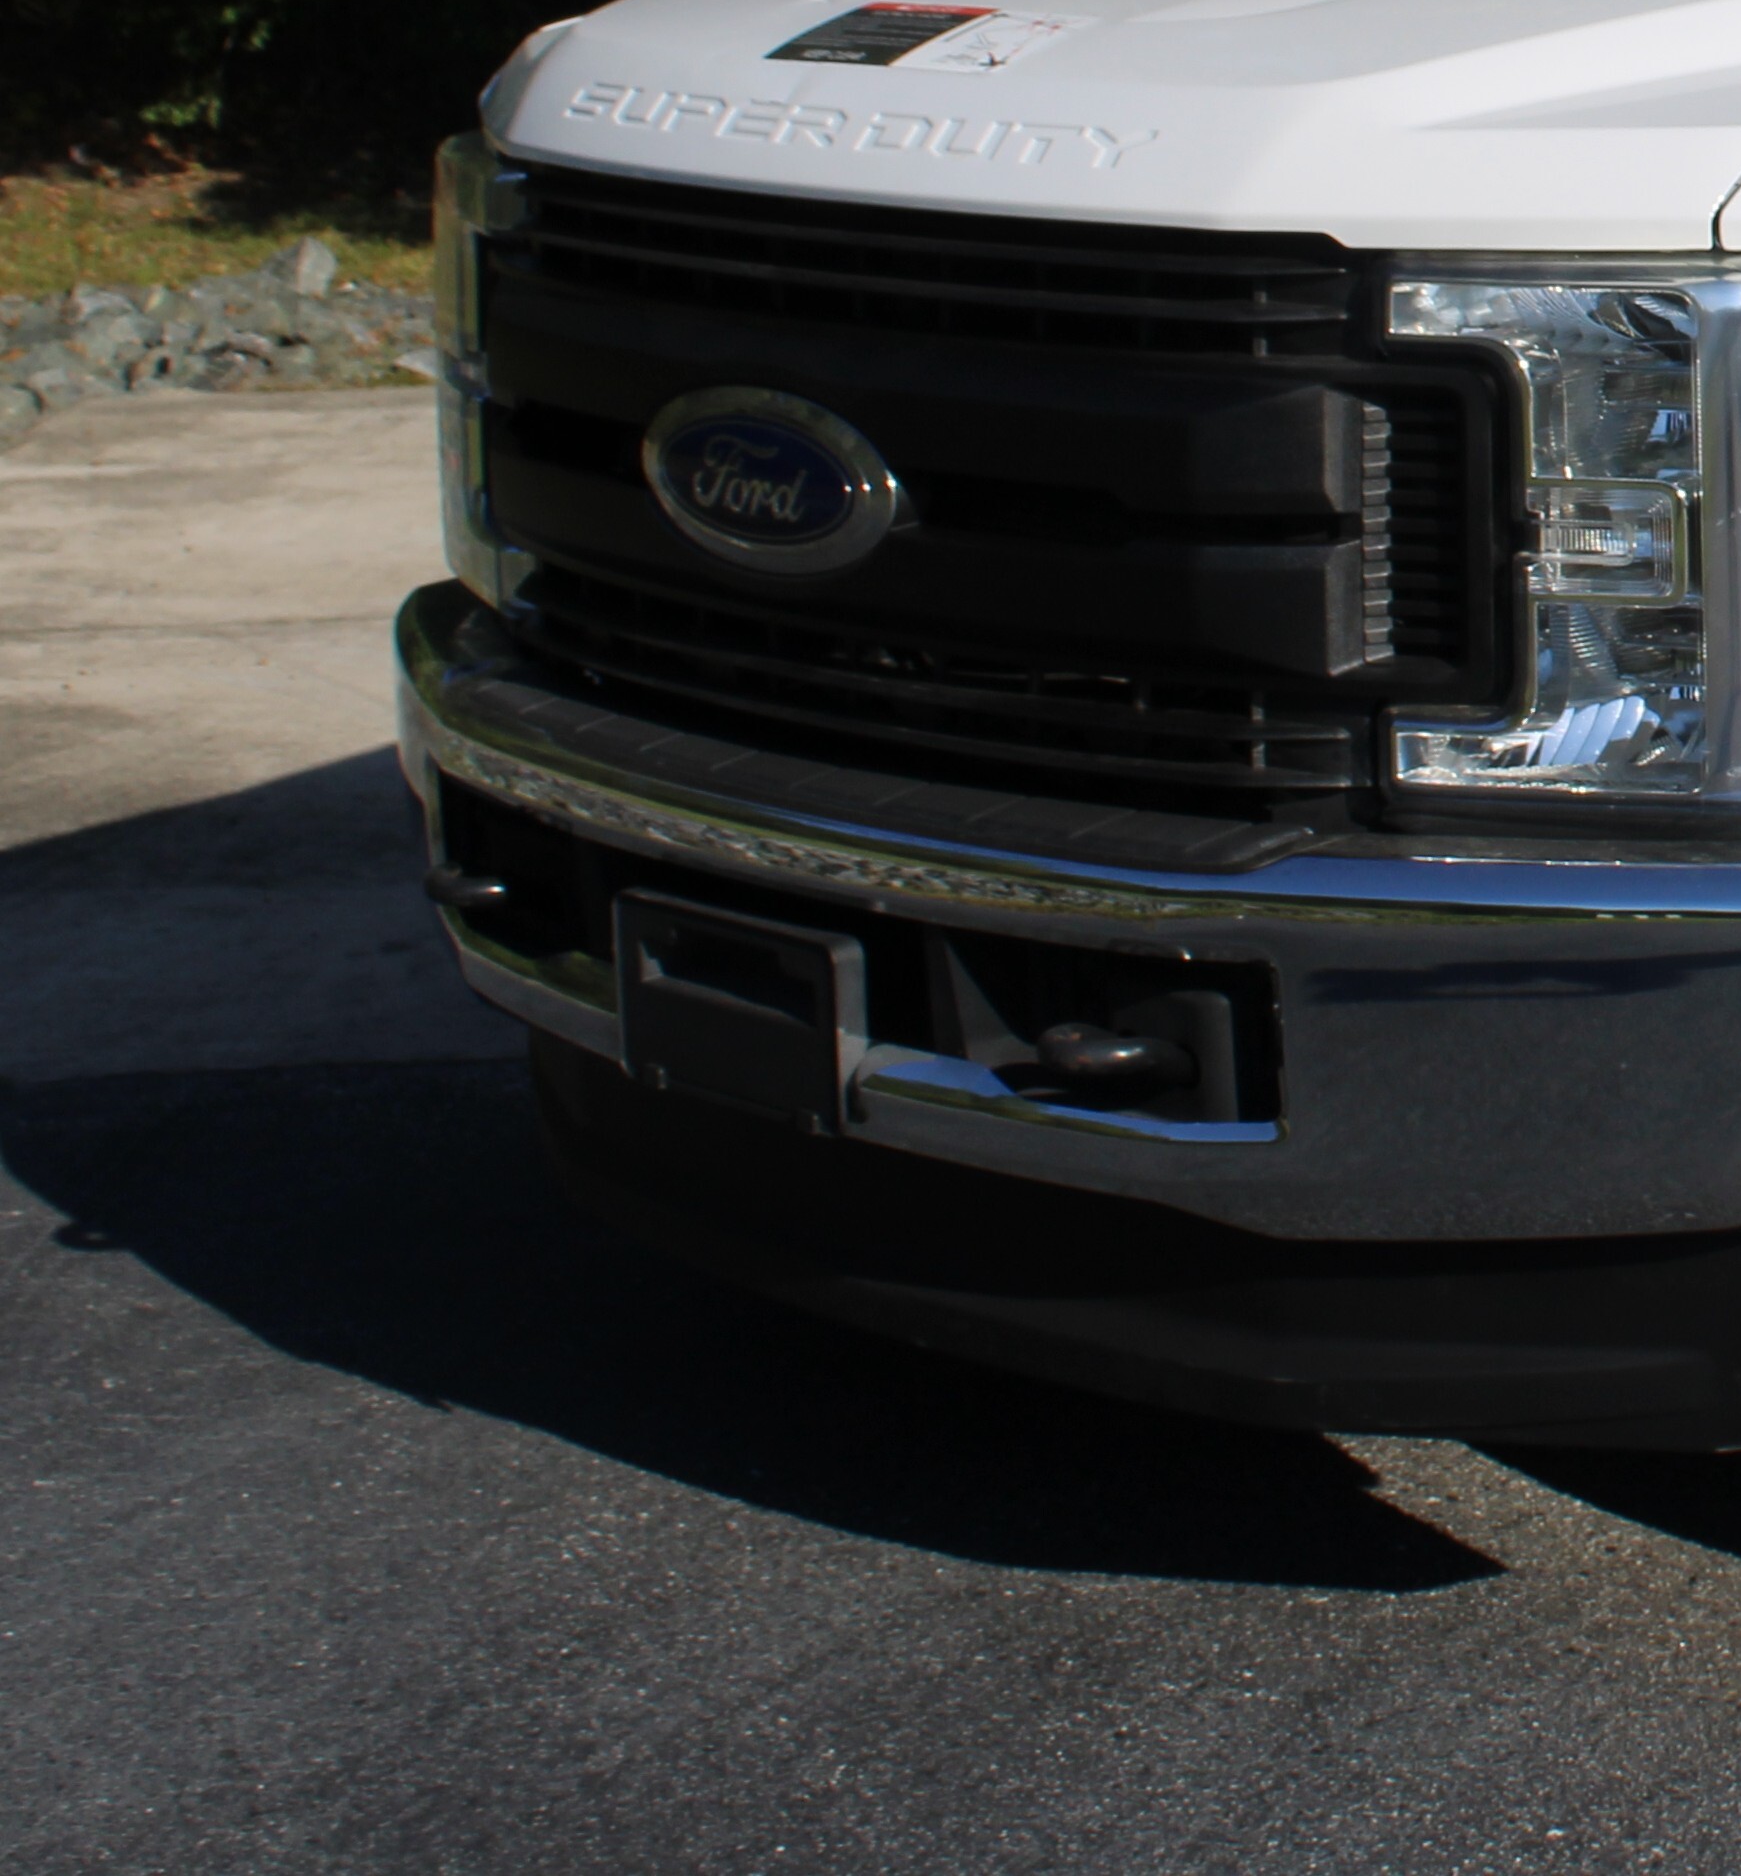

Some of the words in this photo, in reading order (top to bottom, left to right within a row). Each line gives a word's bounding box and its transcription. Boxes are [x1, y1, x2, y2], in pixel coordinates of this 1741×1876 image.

[562, 82, 847, 148] SUPER
[854, 111, 1159, 169] DUTY
[692, 433, 807, 523] Ford
